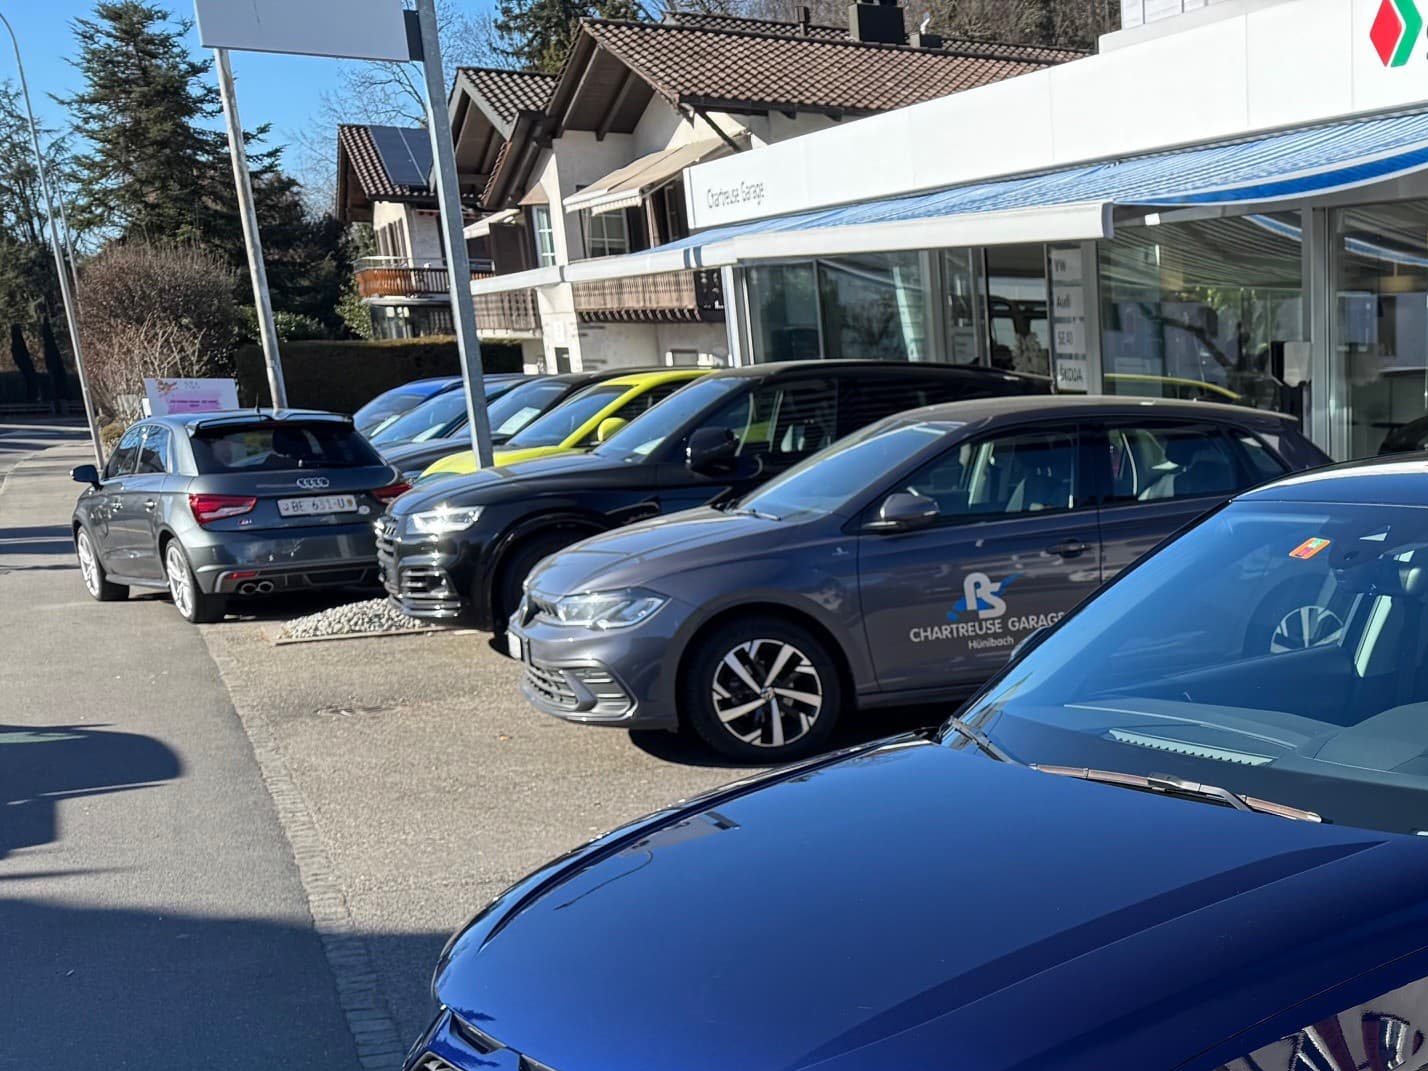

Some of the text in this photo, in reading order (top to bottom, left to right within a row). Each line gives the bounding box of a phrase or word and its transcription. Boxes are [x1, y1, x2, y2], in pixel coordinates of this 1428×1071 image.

[707, 181, 765, 209] Chartreuse Garage
[909, 619, 1003, 643] CHARTREUSE
[968, 635, 1014, 650] Hünibach
